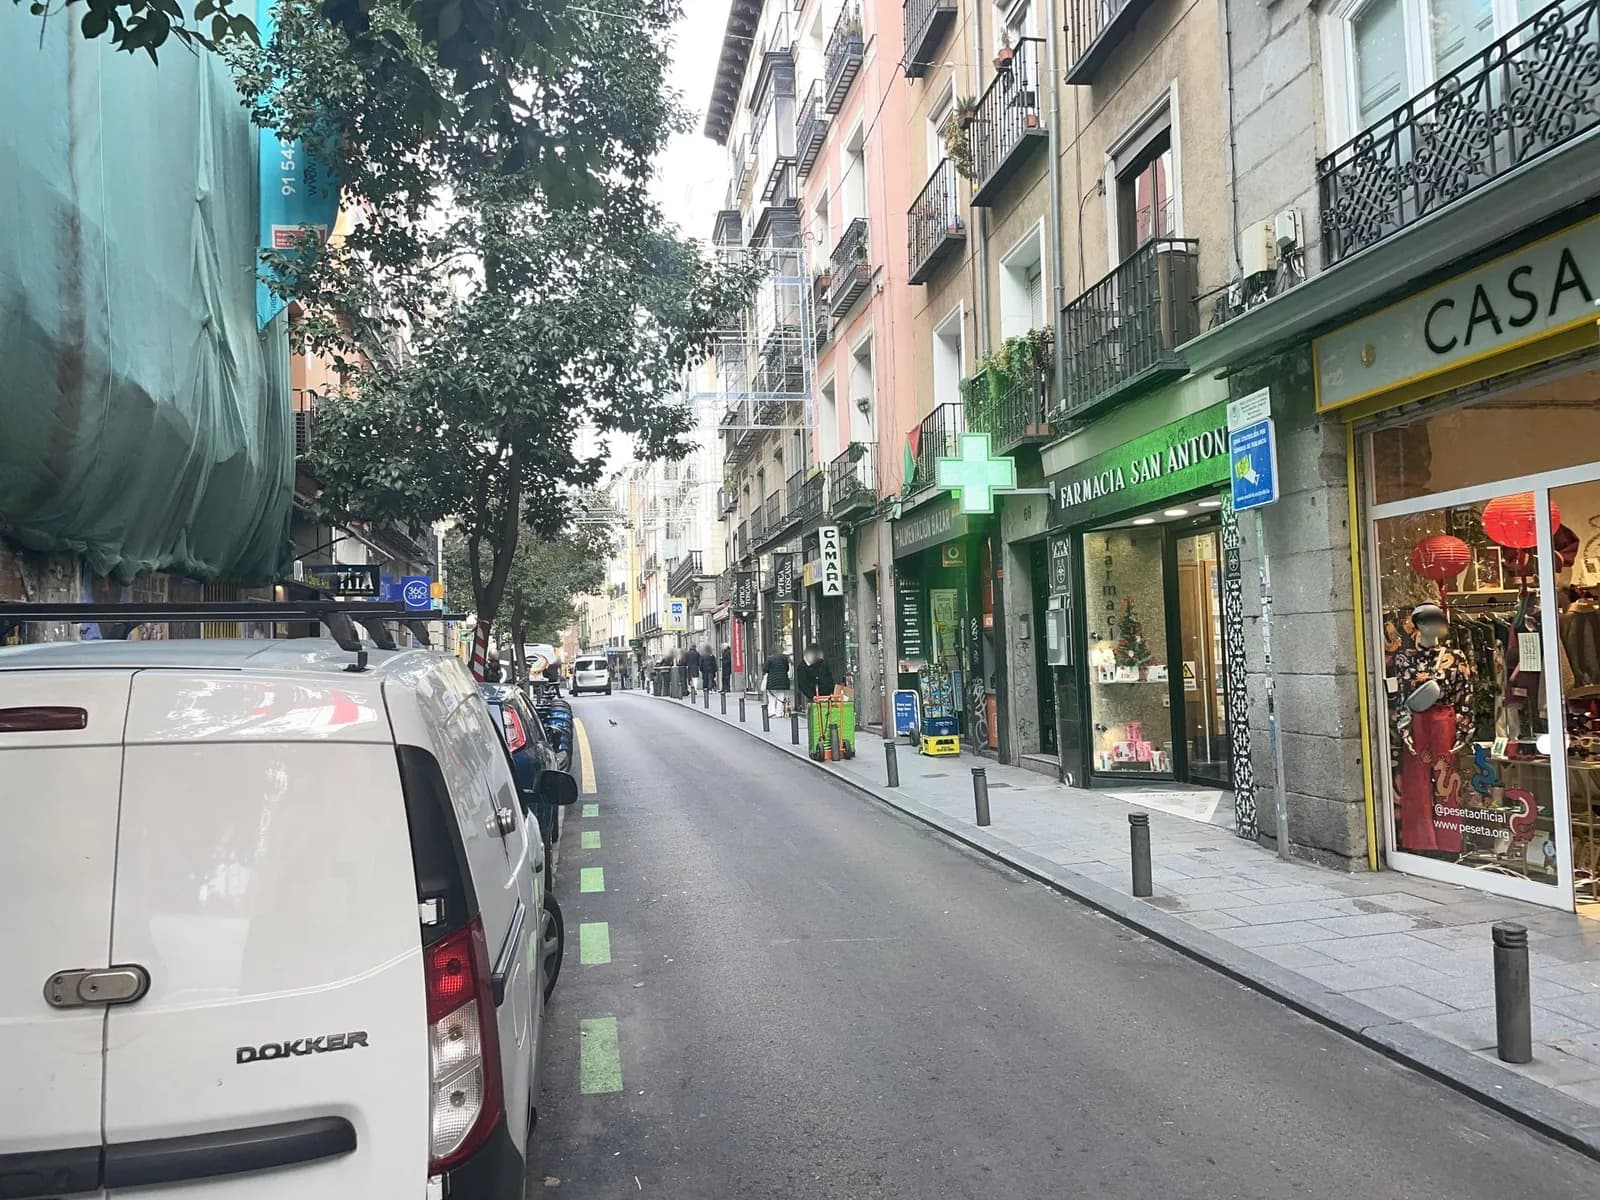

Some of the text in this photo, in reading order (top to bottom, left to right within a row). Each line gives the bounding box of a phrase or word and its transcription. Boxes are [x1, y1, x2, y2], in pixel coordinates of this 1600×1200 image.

[281, 176, 296, 197] 91
[1424, 247, 1594, 355] CASA
[1060, 466, 1126, 509] FARMACIA
[1130, 451, 1162, 485] SAN
[823, 529, 839, 592] CAMARA
[408, 586, 428, 595] 360
[776, 570, 785, 598] ÓPTICA
[1102, 537, 1116, 641] farmaci
[1434, 803, 1507, 824] @pesetaofficial
[236, 1031, 369, 1064] DOKKER
